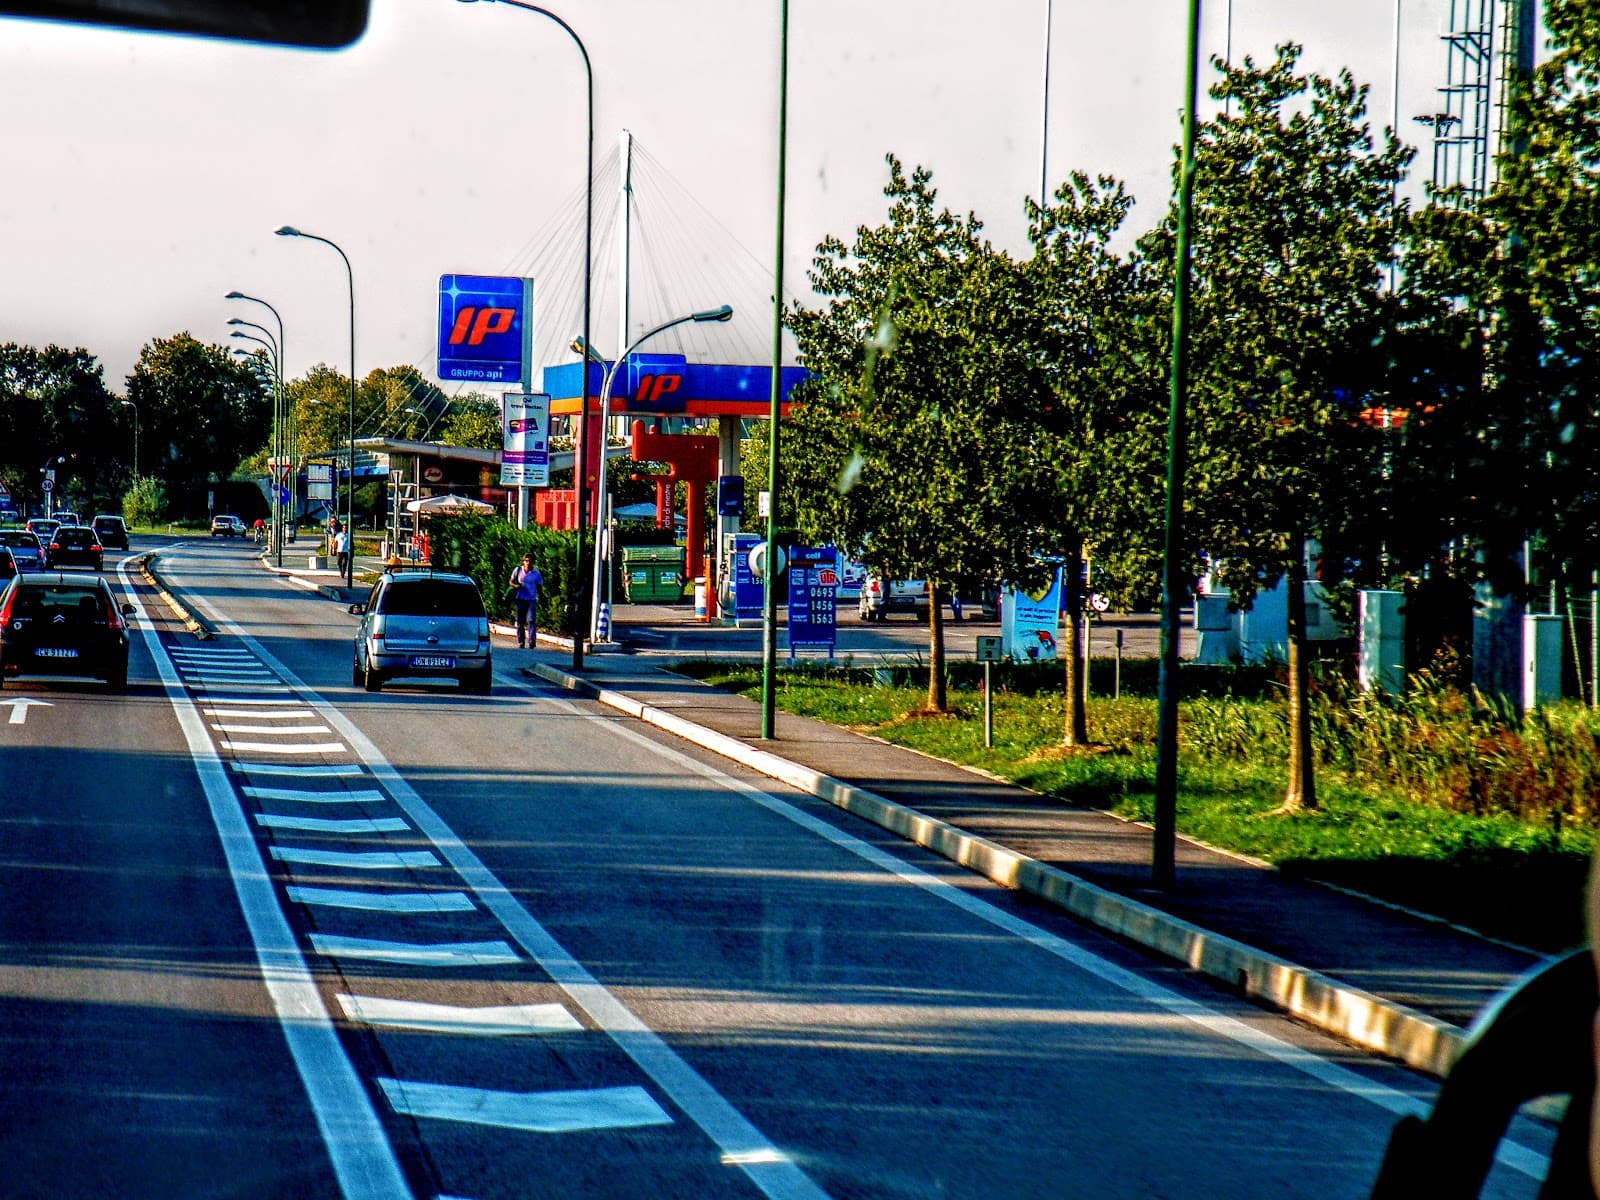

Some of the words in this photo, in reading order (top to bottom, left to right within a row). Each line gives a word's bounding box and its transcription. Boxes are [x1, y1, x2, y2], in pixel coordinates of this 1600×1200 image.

[448, 306, 516, 346] IP
[450, 368, 485, 378] GRUPPO
[486, 366, 503, 380] api
[635, 374, 682, 402] IP
[810, 587, 834, 598] 0695
[811, 600, 833, 611] 1456
[811, 613, 833, 625] 1563
